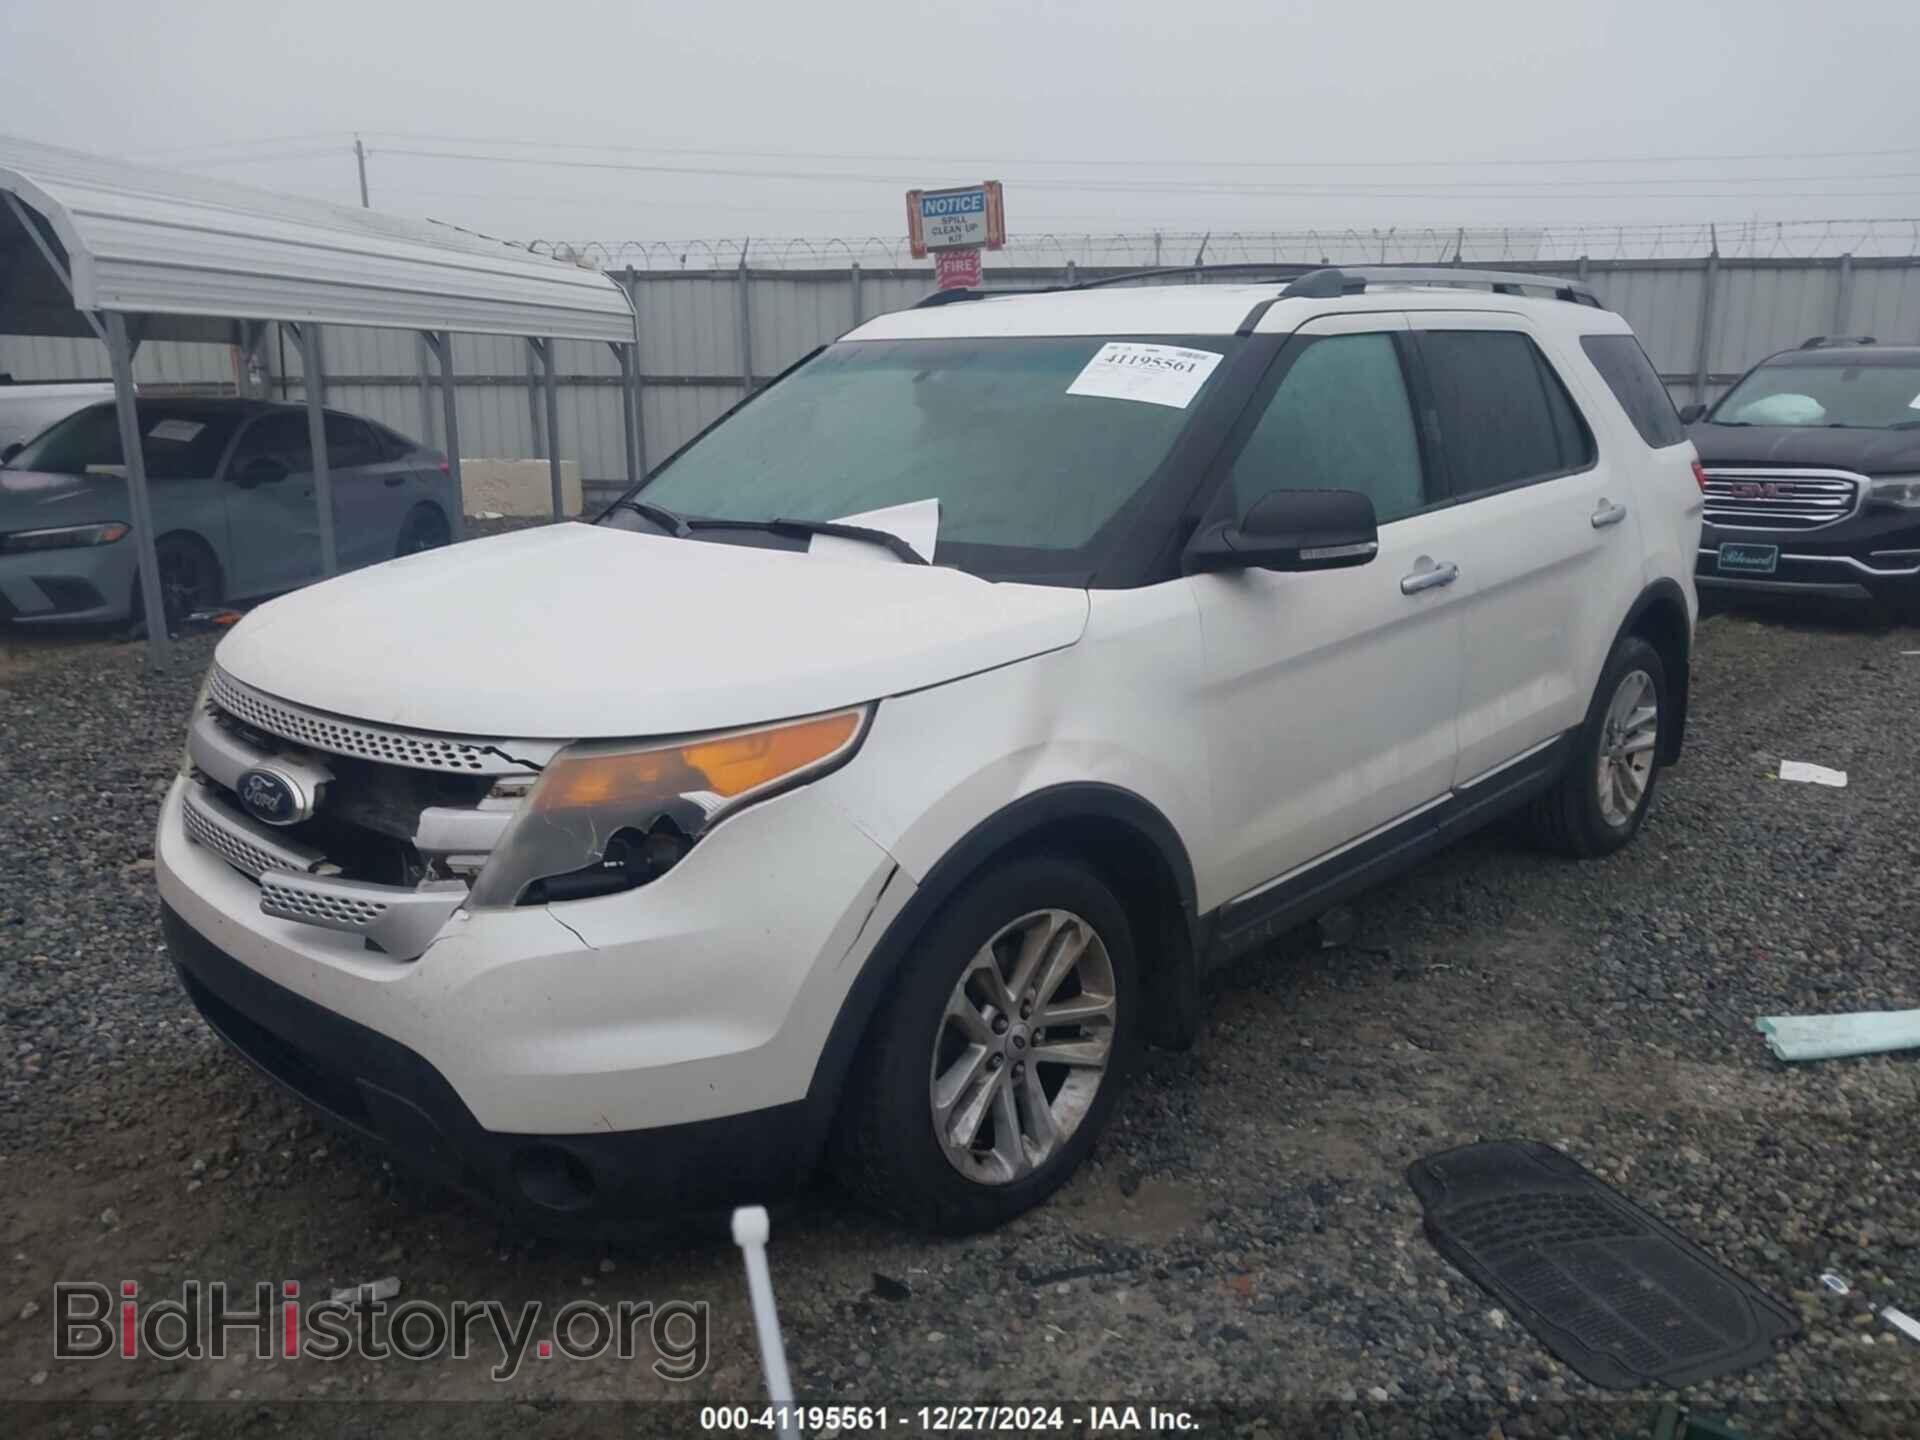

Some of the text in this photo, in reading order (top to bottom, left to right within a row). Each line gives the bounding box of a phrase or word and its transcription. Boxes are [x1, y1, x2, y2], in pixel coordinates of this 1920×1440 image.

[925, 195, 982, 214] NOTICE
[942, 216, 968, 225] SPILL
[932, 222, 978, 235] CLEAN UP
[949, 235, 963, 243] KIT
[943, 260, 974, 272] FIRE
[1105, 354, 1196, 373] 41195561
[1730, 482, 1794, 499] GMC
[244, 775, 283, 812] Ford
